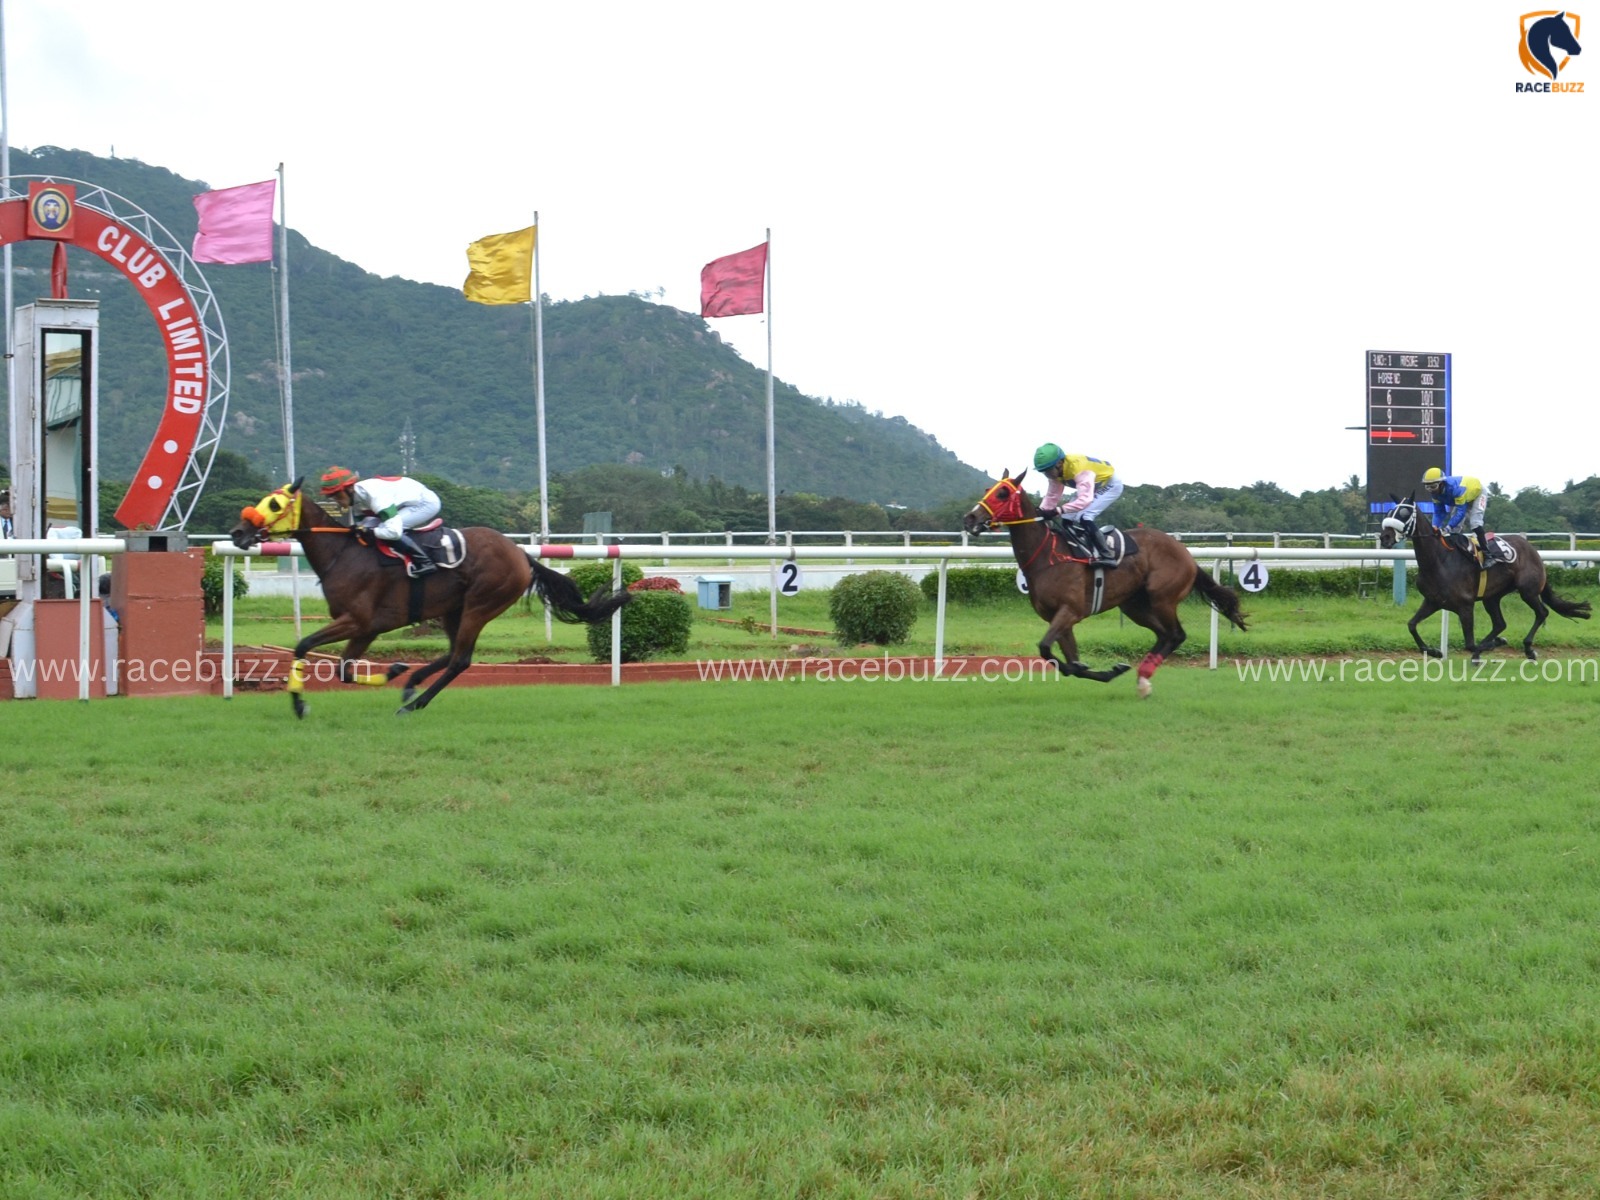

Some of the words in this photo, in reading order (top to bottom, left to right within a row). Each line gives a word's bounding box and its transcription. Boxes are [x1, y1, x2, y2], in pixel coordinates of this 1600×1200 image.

[97, 225, 167, 289] CLUB
[158, 297, 205, 415] LIMITED
[1386, 389, 1392, 405] 6
[1386, 408, 1392, 424] 9
[1387, 427, 1392, 443] 2
[1496, 540, 1513, 560] 5
[782, 563, 798, 592] 2
[1243, 563, 1262, 589] 4
